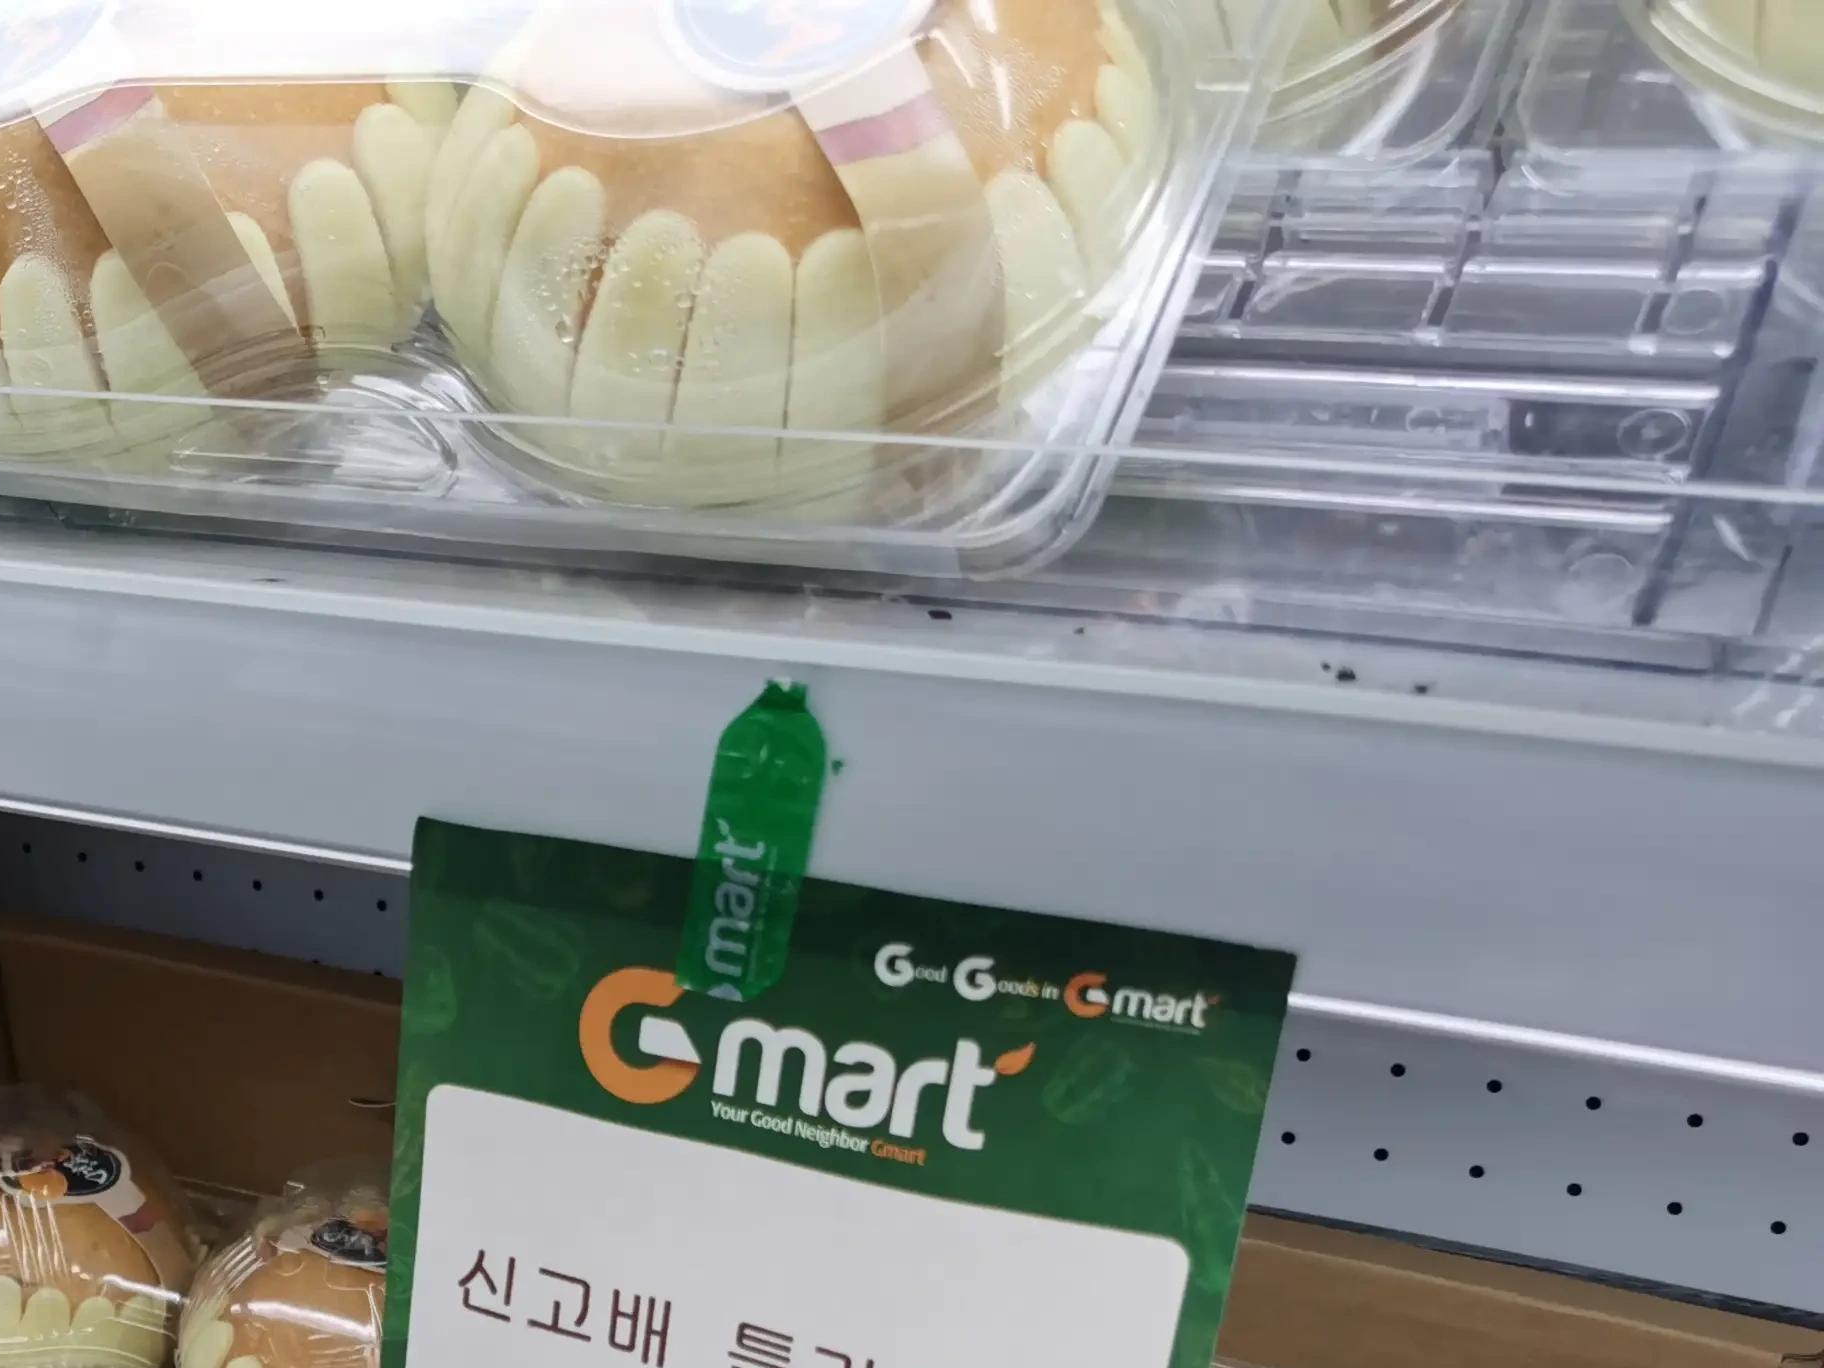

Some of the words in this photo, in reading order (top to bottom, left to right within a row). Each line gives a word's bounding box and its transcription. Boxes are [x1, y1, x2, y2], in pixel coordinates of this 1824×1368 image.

[874, 942, 947, 987] Good
[953, 956, 1039, 1002] Goods
[711, 1101, 749, 1124] Your
[750, 1109, 793, 1135] Good
[794, 1119, 869, 1154] Neighbor
[870, 1139, 925, 1166] Gmart
[457, 1250, 672, 1368] 신고배
